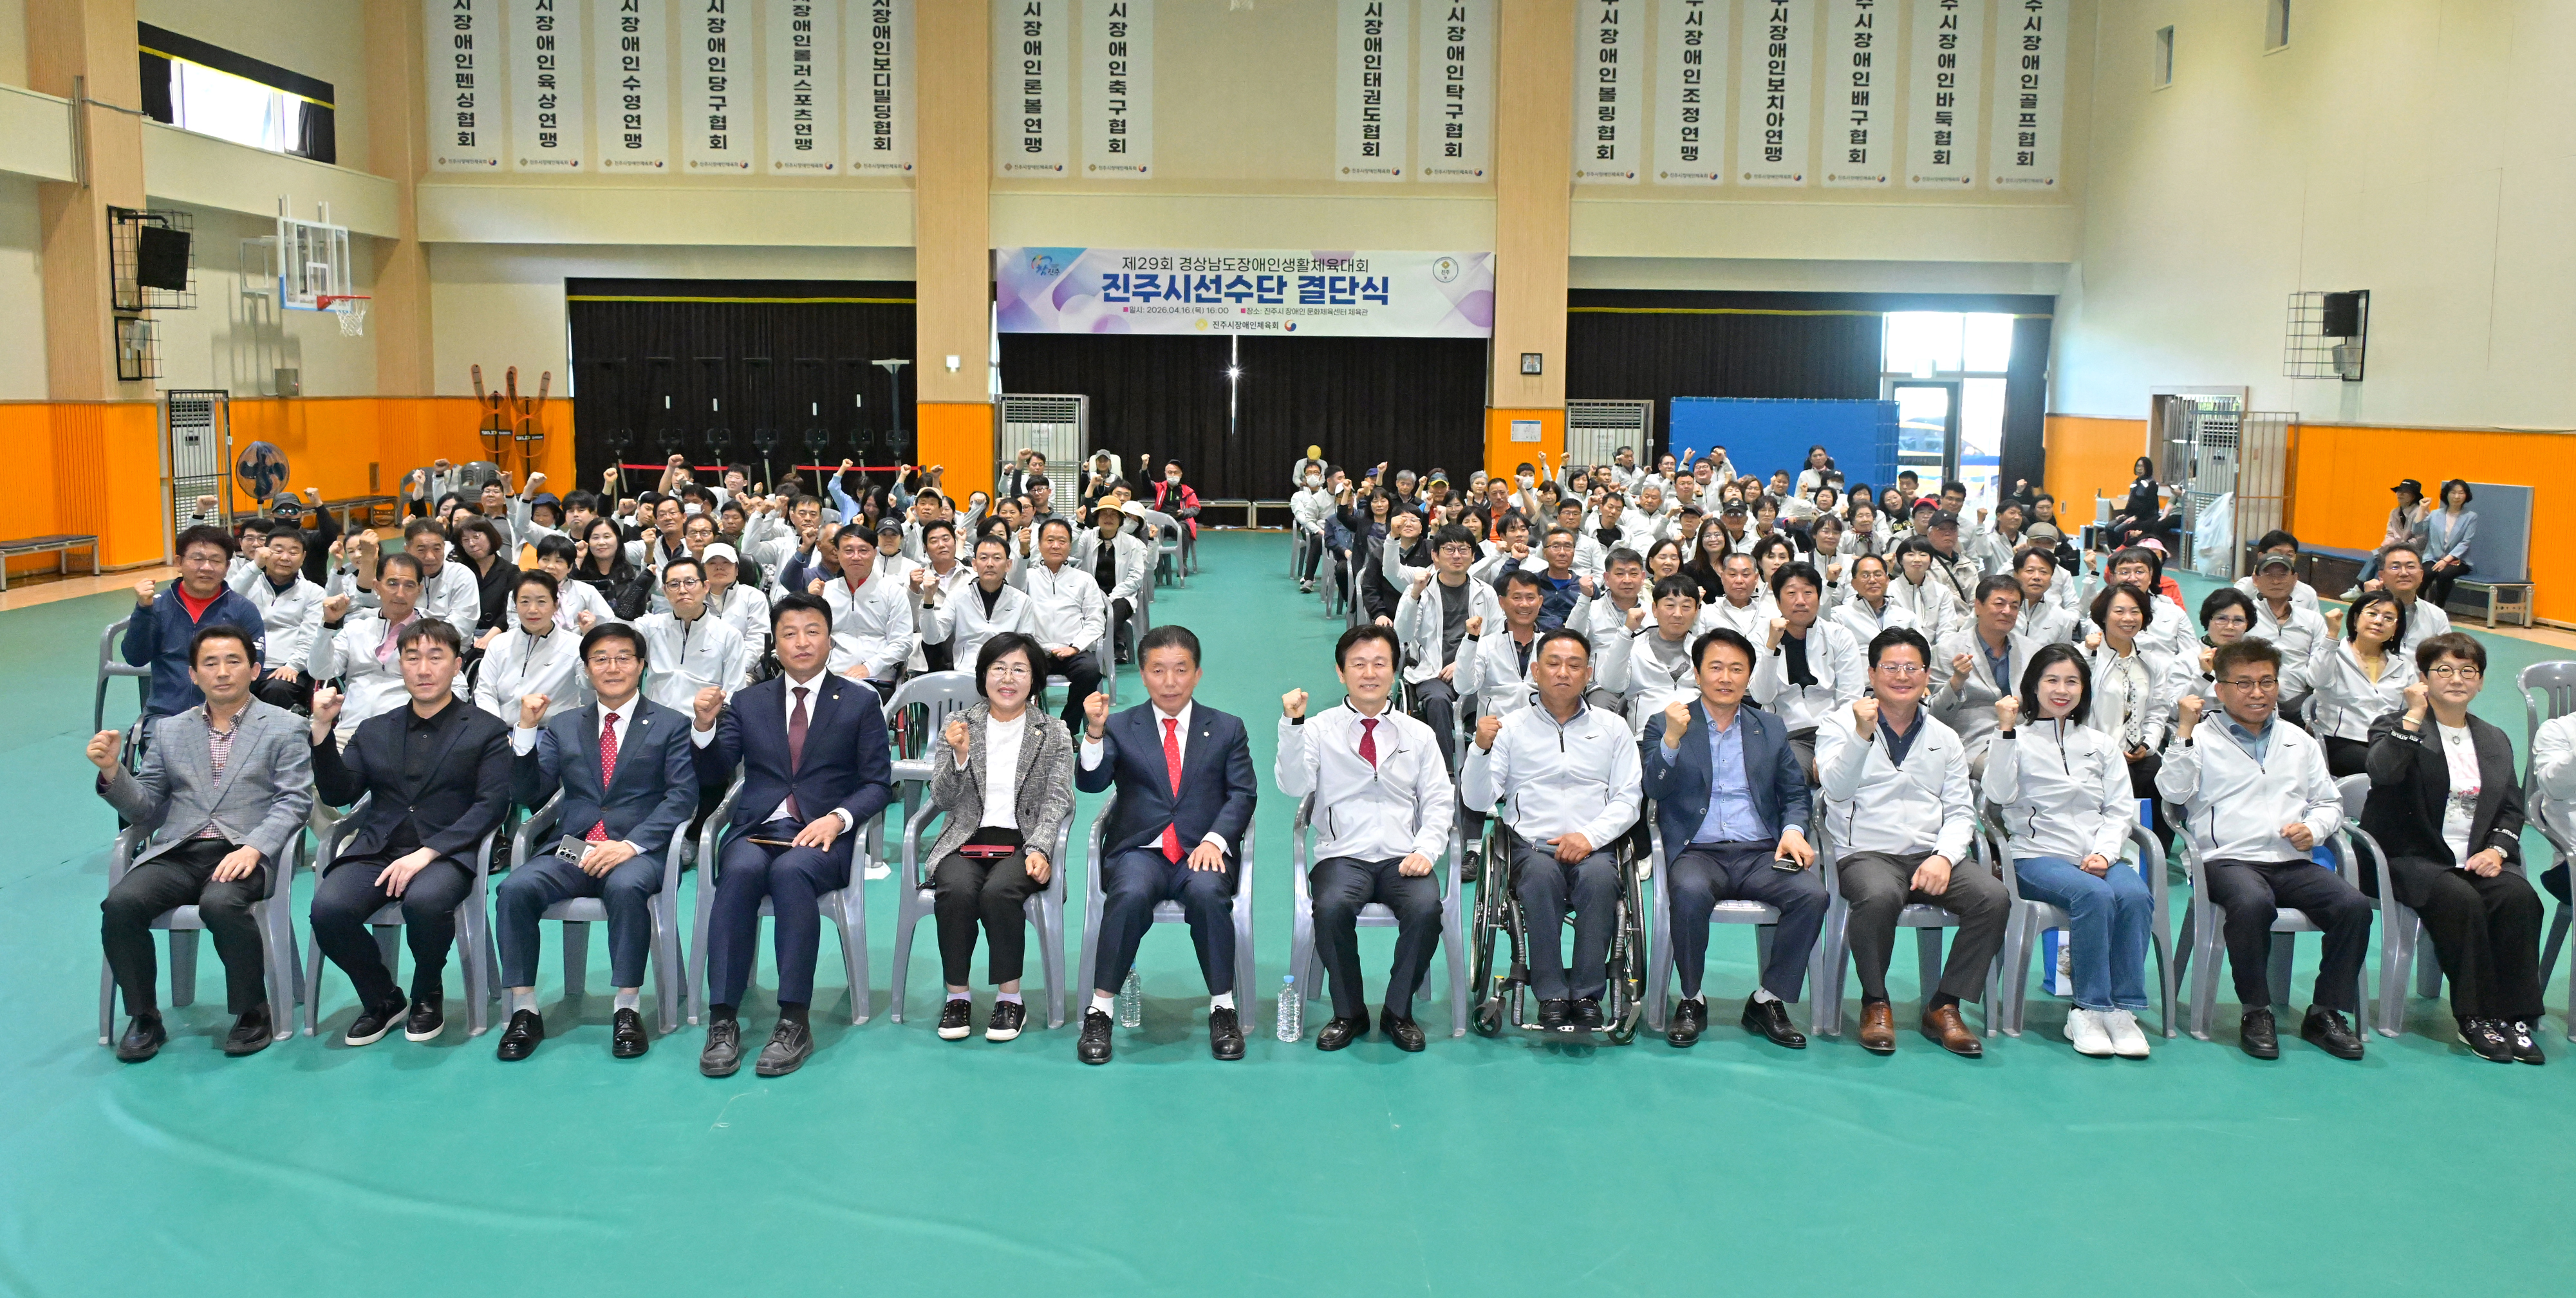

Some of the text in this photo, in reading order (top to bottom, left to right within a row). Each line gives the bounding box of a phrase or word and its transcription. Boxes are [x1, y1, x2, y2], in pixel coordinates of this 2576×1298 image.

[793, 0, 812, 151] 장애인러스포츠연맹
[1108, 3, 1128, 154] 시장애인축구협회
[1362, 2, 1383, 157] 시장애인태권도협회
[1444, 0, 1466, 158] 시장애인탁구협회
[1597, 0, 1619, 160] 시장애인볼링협회
[1101, 273, 1389, 306] 진주시선수단 결단식
[1122, 256, 1368, 273] 제29회 경상남도장애인생활체육대회
[1212, 320, 1279, 330] 진주시장애인체육회
[1307, 308, 1347, 316] 문화체육센터
